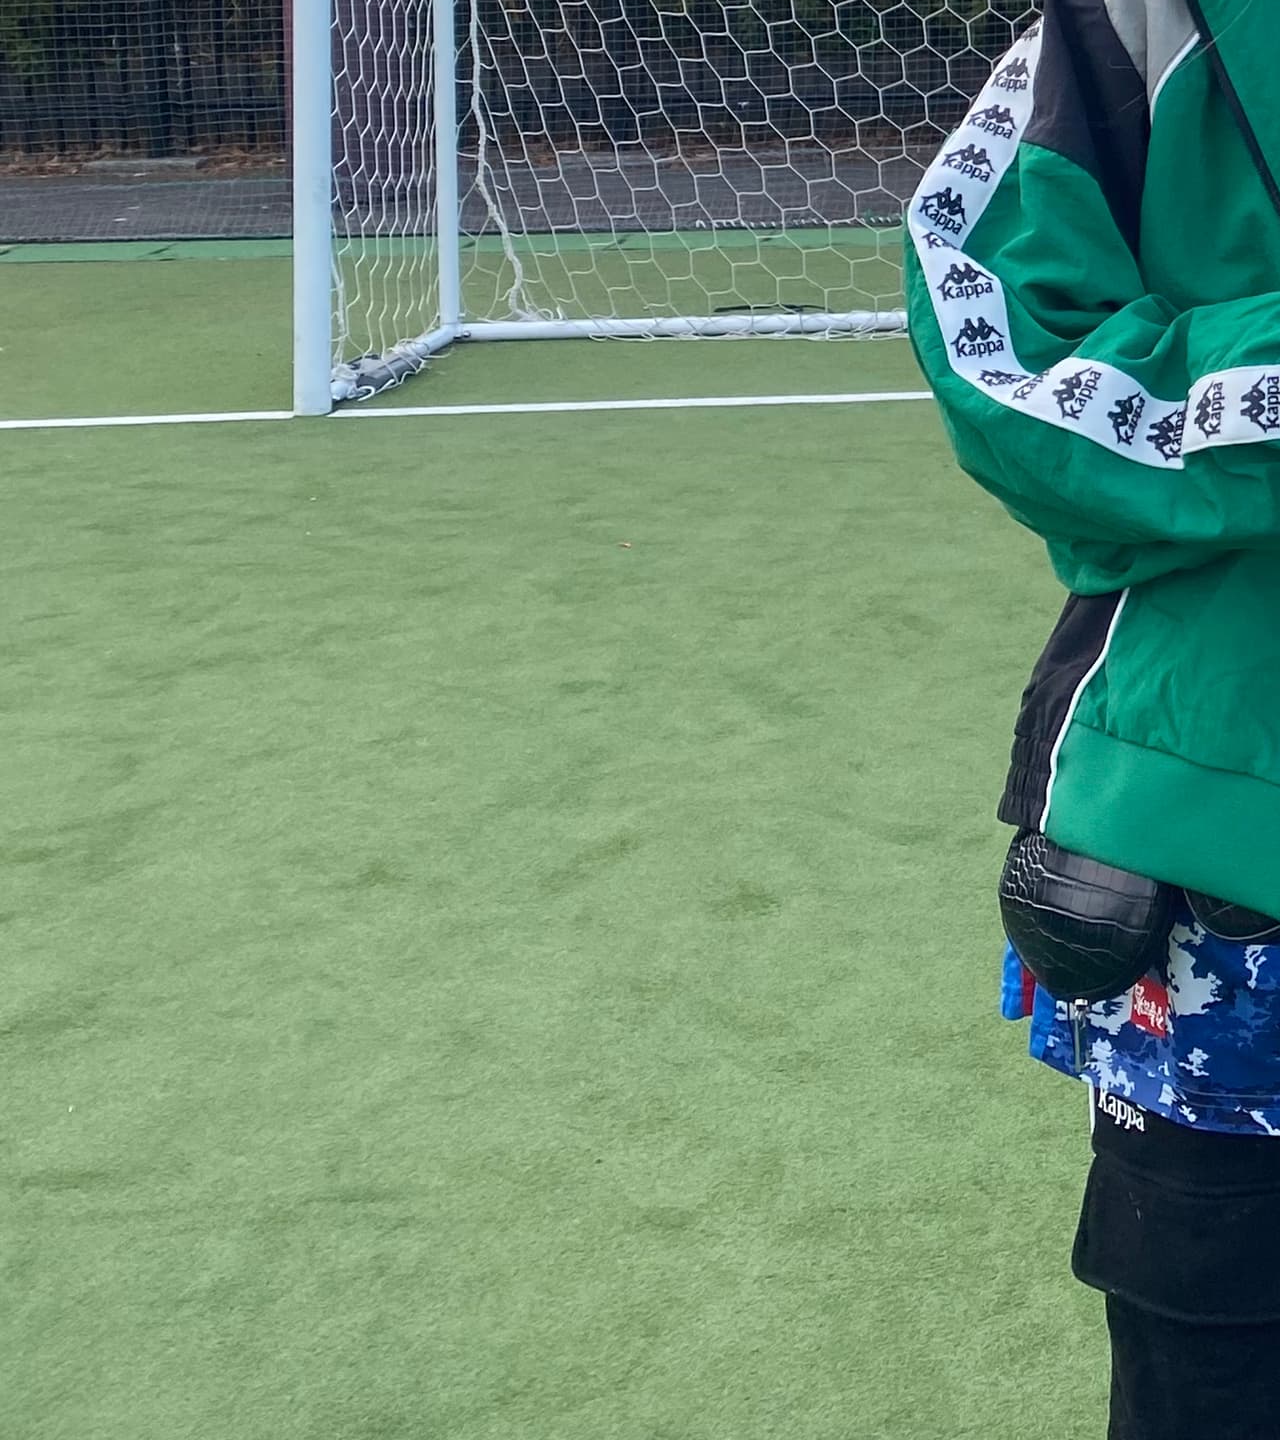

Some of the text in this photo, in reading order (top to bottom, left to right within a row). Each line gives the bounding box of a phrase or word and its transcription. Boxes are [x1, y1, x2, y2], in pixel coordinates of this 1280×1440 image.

[990, 75, 1028, 94] Kappa
[966, 116, 1014, 140] Kappa
[941, 154, 991, 183] Kappa
[918, 198, 963, 236] Kappa
[941, 281, 994, 301] Kappa
[955, 339, 1005, 358] Kappa
[1062, 370, 1102, 421] Kappa
[1206, 382, 1225, 439] Kappa
[1098, 1088, 1145, 1132] Kappa
